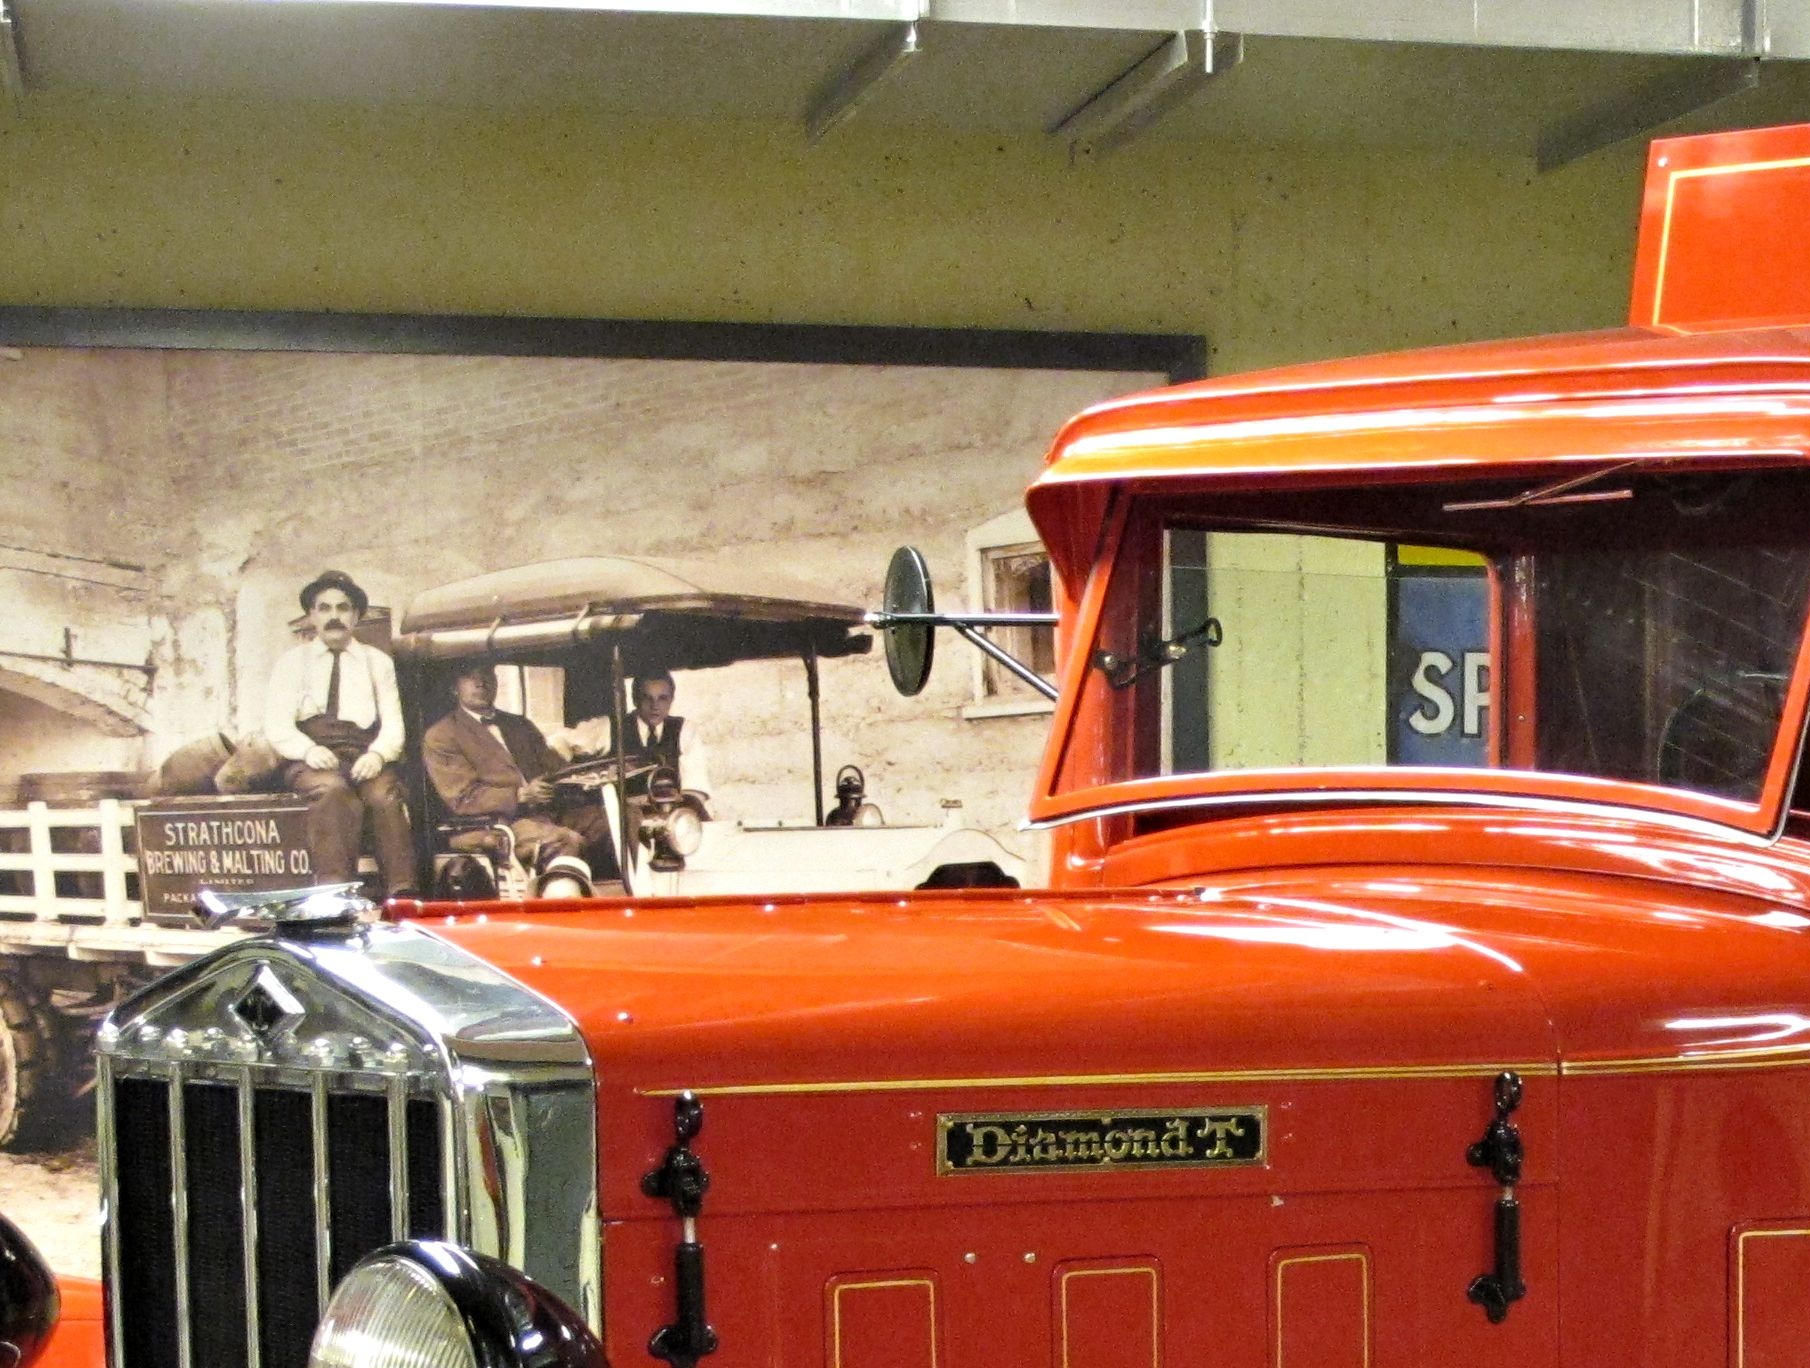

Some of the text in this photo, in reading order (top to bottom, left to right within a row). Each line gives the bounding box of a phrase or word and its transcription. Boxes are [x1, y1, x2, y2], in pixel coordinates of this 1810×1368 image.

[164, 819, 281, 846] STRATHCONA
[147, 850, 312, 875] BREWING & MALTING CO.
[966, 1117, 1245, 1165] Diamond T
